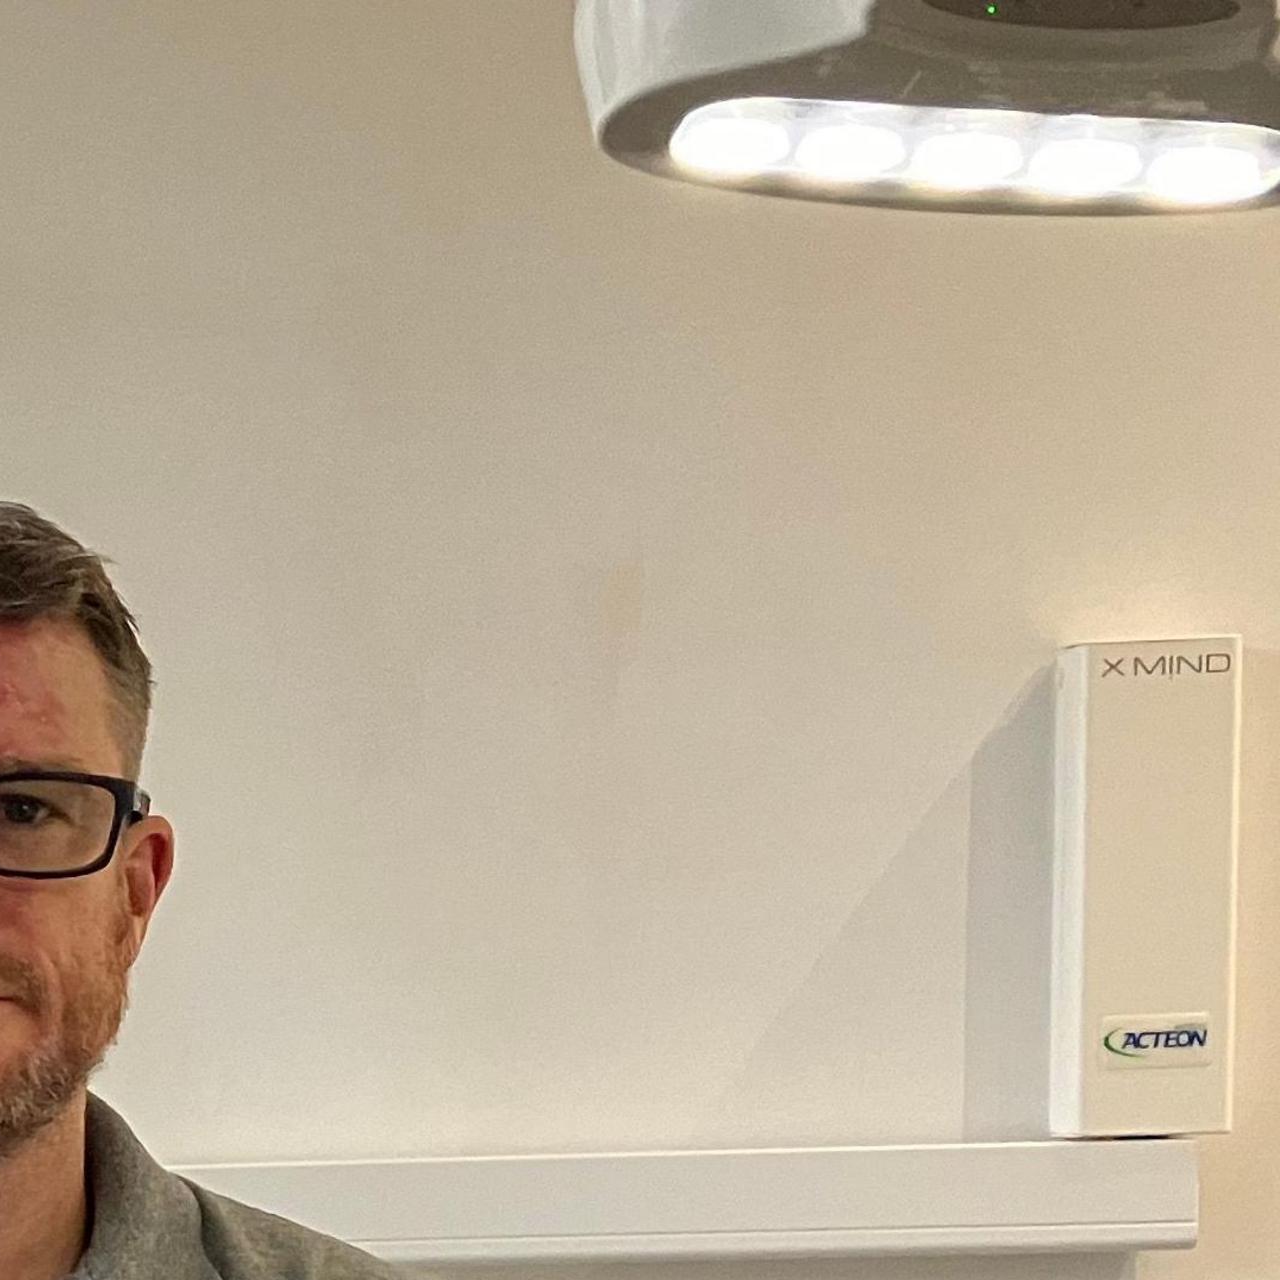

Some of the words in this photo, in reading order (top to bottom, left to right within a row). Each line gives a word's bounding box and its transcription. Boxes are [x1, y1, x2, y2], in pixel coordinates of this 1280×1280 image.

[1101, 658, 1125, 678] X
[1133, 653, 1232, 676] MIND
[1121, 1028, 1208, 1050] ACTEON
